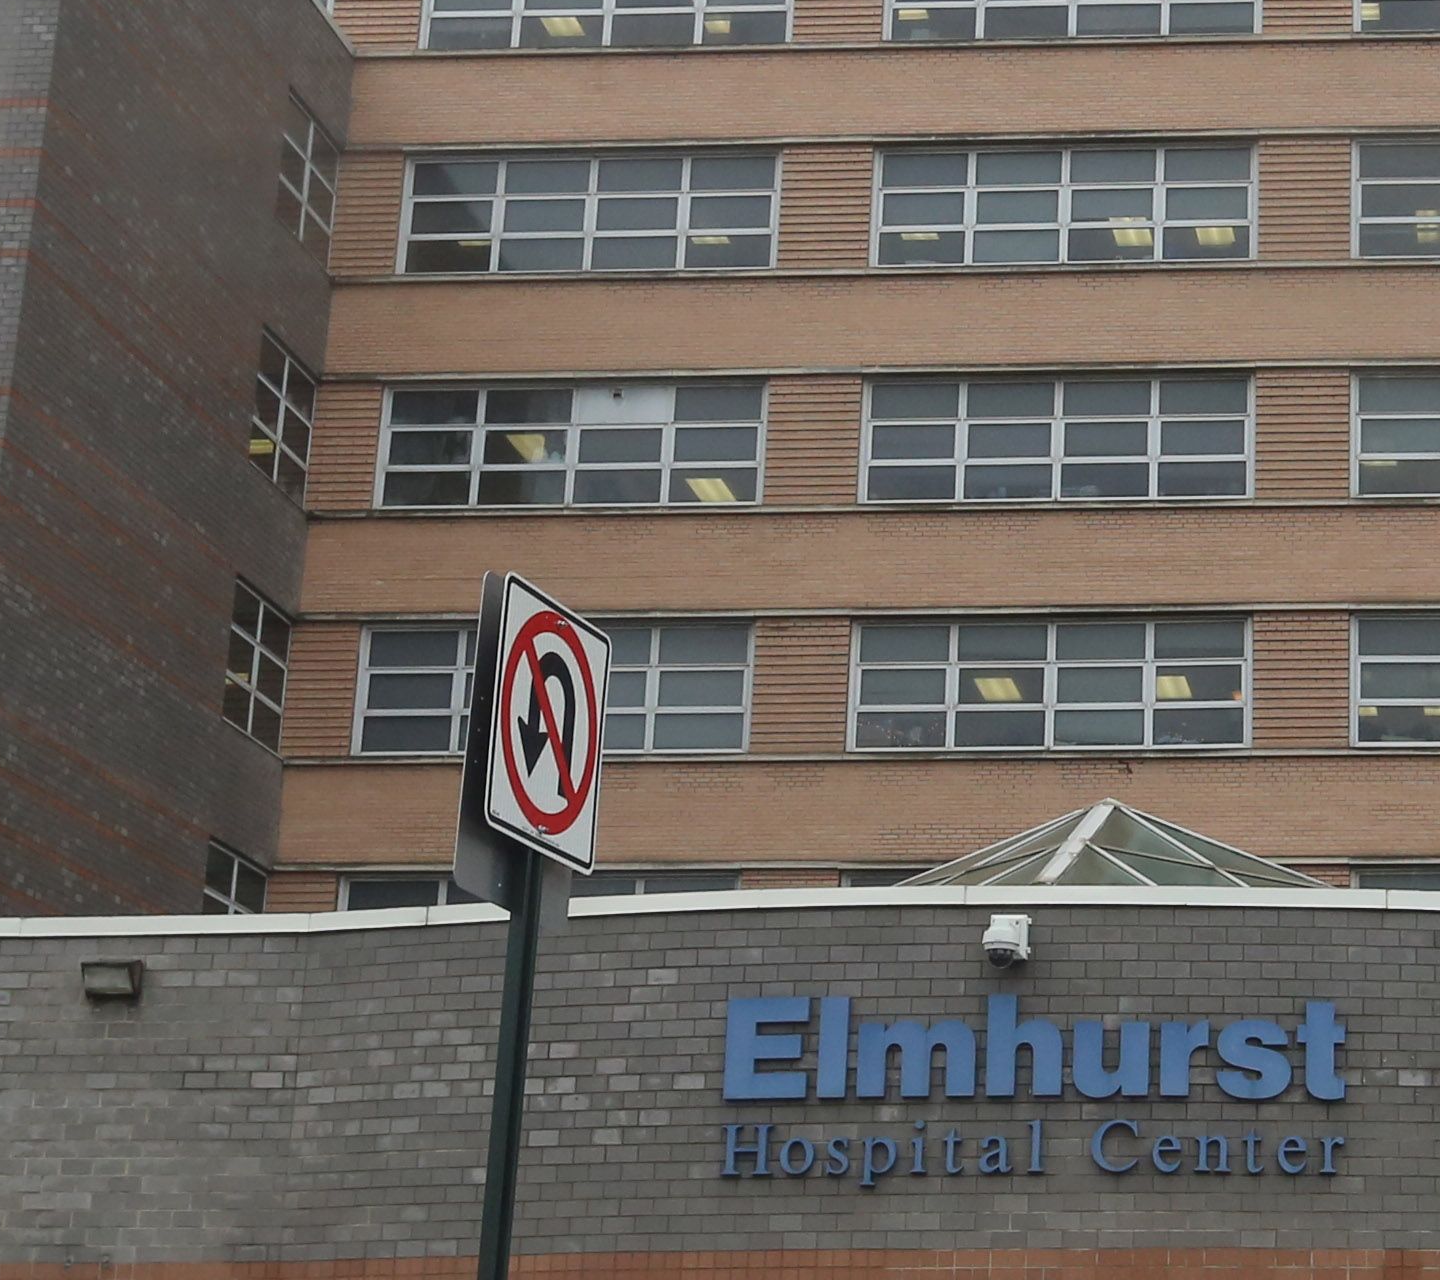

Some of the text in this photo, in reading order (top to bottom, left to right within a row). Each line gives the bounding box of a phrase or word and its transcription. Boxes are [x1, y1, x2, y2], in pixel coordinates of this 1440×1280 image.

[722, 994, 1347, 1101] Elmhurst
[718, 1118, 1346, 1188] Hospital Center
